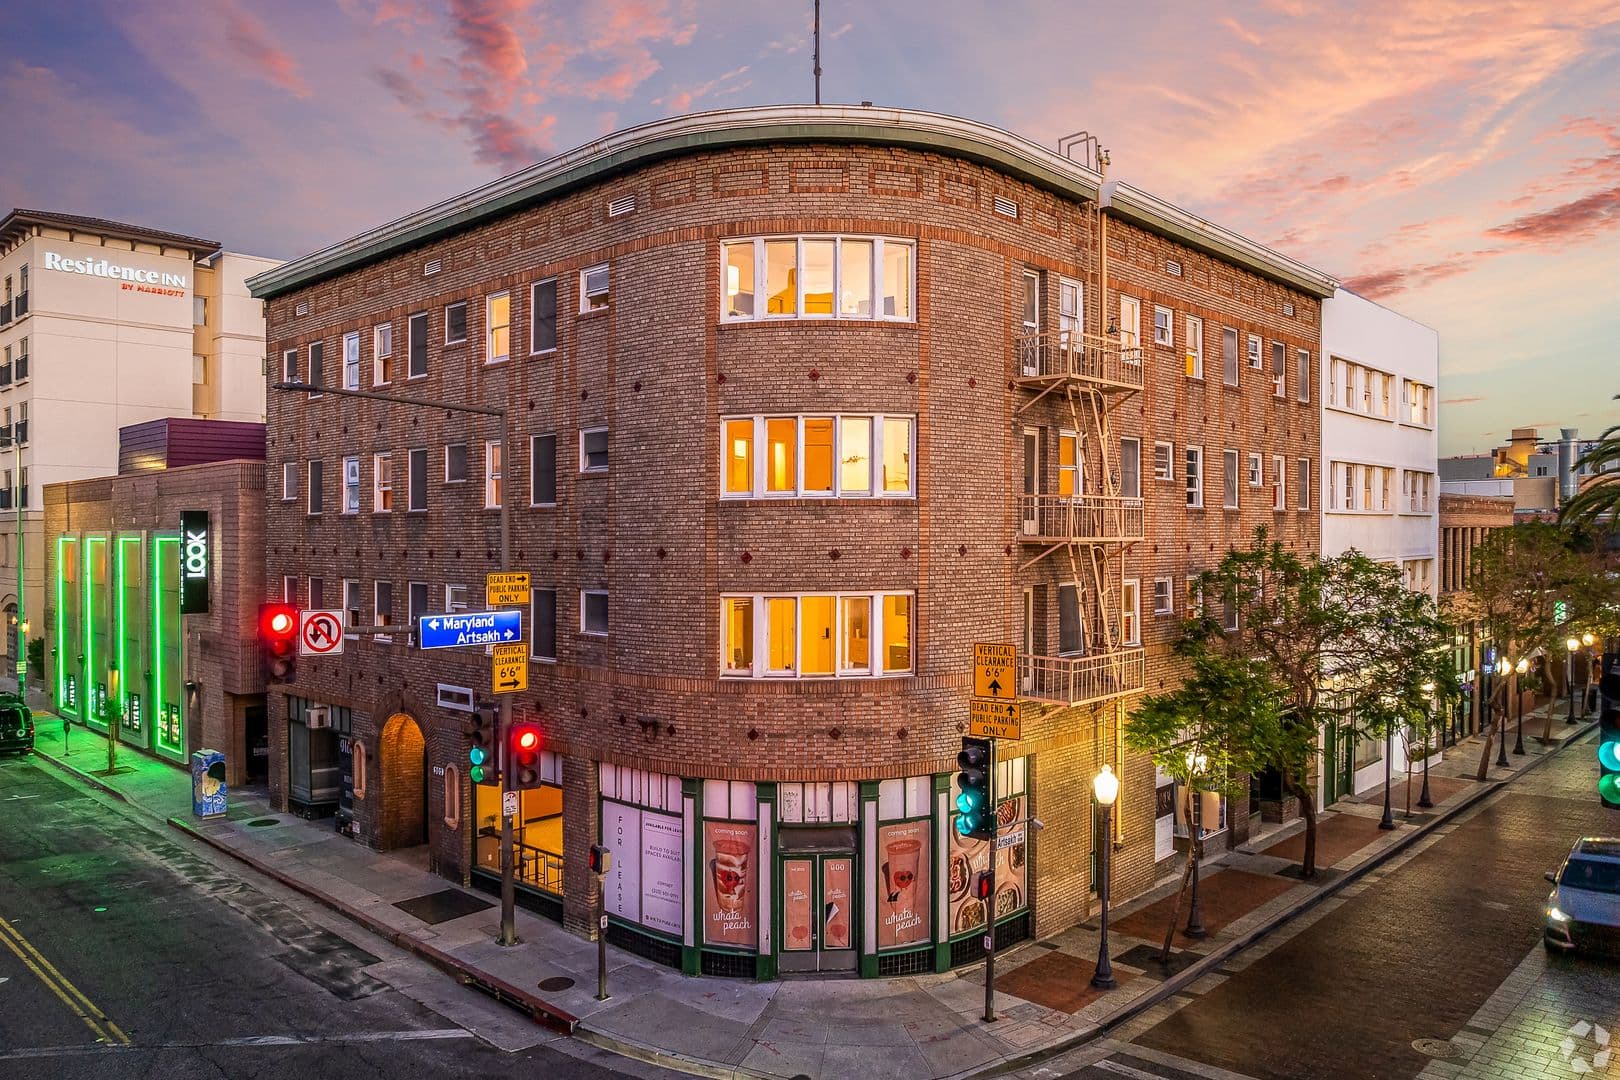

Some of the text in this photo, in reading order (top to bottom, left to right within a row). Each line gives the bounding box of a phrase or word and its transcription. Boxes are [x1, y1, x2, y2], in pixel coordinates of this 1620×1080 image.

[44, 251, 186, 288] Residence INN
[121, 283, 185, 298] BY MARRIOTT
[186, 530, 206, 578] LOOK
[490, 576, 516, 584] DEAD END
[490, 584, 528, 594] PUBLIC PARKING
[443, 616, 494, 632] Maryland
[457, 630, 500, 644] Artsakh
[495, 646, 525, 655] VERTICAL
[978, 646, 1012, 656] VERTICAL
[495, 656, 526, 666] CLEARANCE
[976, 656, 1014, 668] CLEARANCE
[972, 702, 1003, 713] DEAD END
[972, 714, 1018, 726] PUBLIC PARKING
[983, 726, 1007, 736] ONLY
[887, 829, 907, 837] coming
[998, 836, 1016, 848] Artsakh
[713, 907, 742, 920] whata
[885, 908, 913, 925] whata
[723, 917, 751, 936] peach
[895, 913, 921, 937] peach
